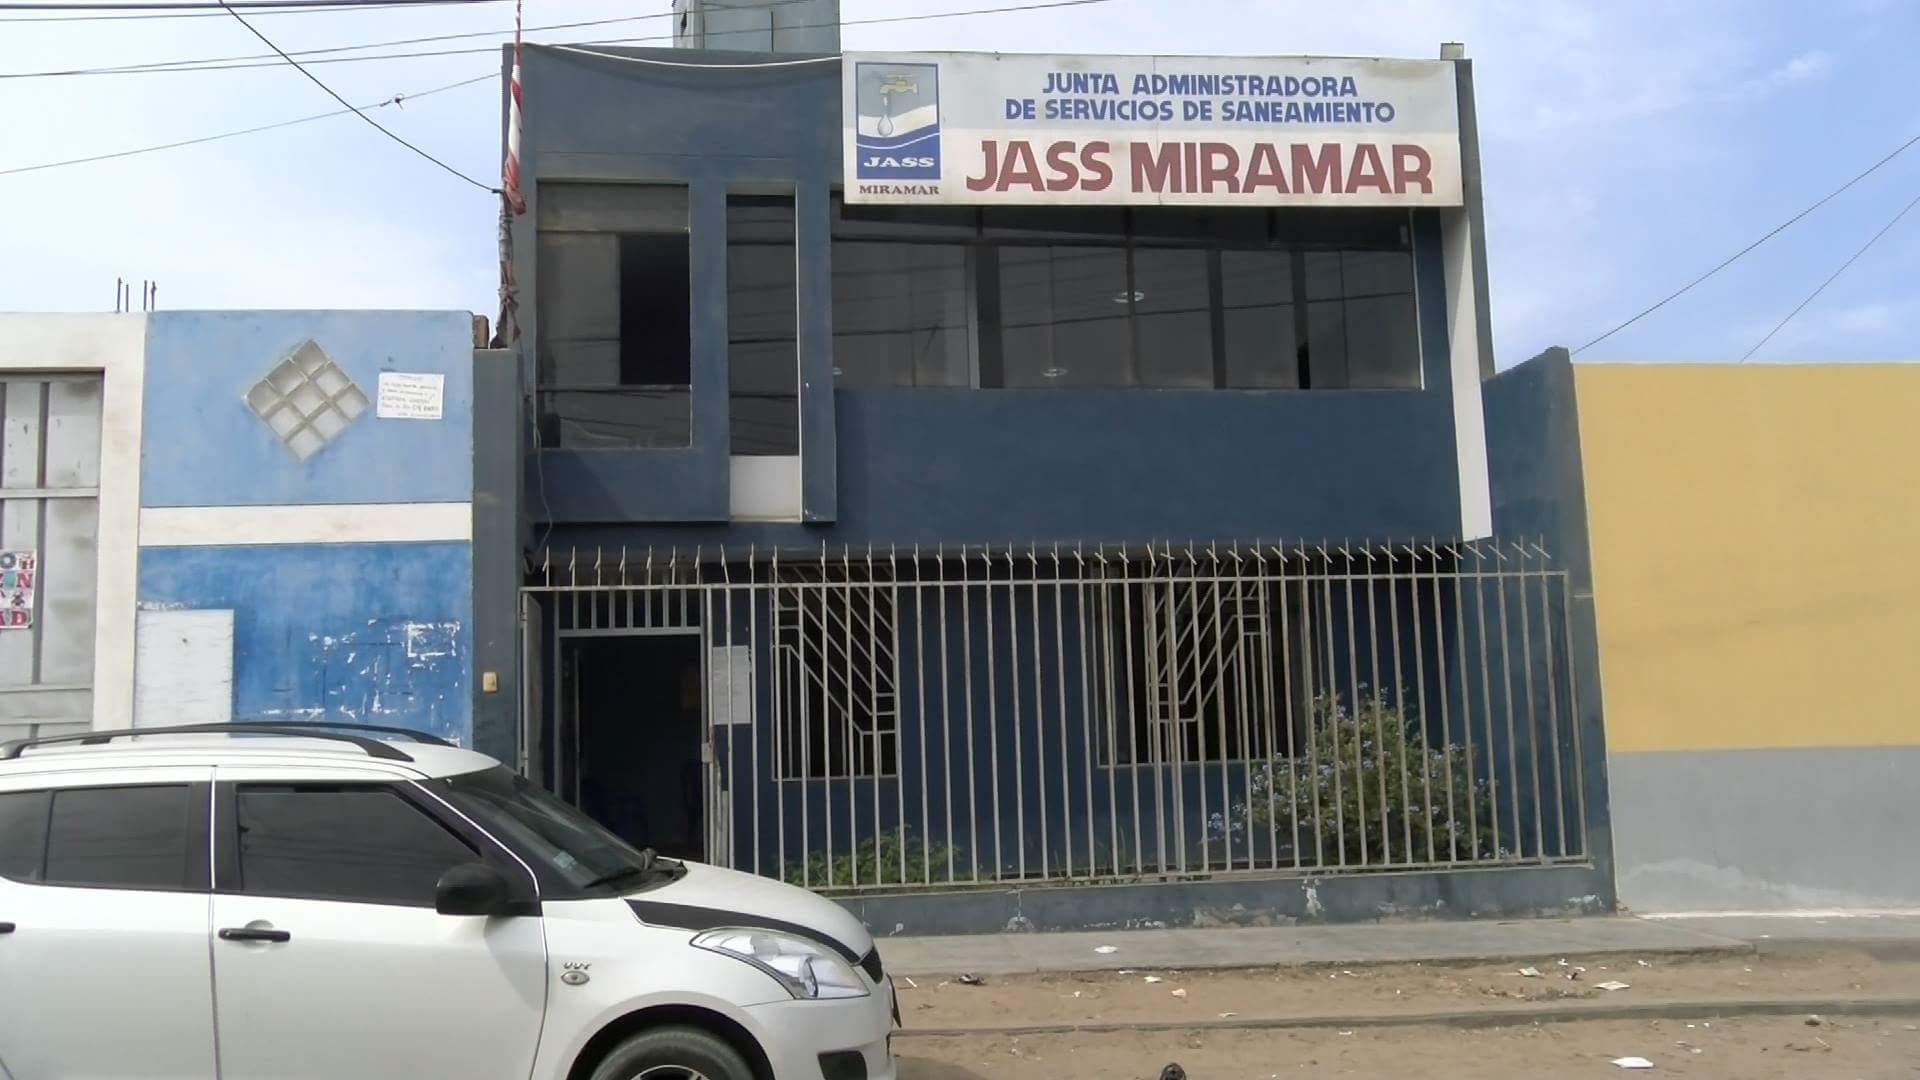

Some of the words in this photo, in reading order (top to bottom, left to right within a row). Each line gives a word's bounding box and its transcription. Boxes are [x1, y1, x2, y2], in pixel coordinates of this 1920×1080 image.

[1042, 72, 1119, 94] JUNTA
[1132, 74, 1358, 97] ADMINISTRADORA
[1005, 98, 1035, 120] DE
[1045, 99, 1173, 121] SERVICIOS
[1183, 100, 1212, 122] DE
[1221, 101, 1395, 123] SANEAMIENTO
[863, 156, 935, 168] JASS
[966, 140, 1113, 192] JASS
[1130, 141, 1433, 194] MIRAMAR
[859, 185, 939, 195] MIRAMAR
